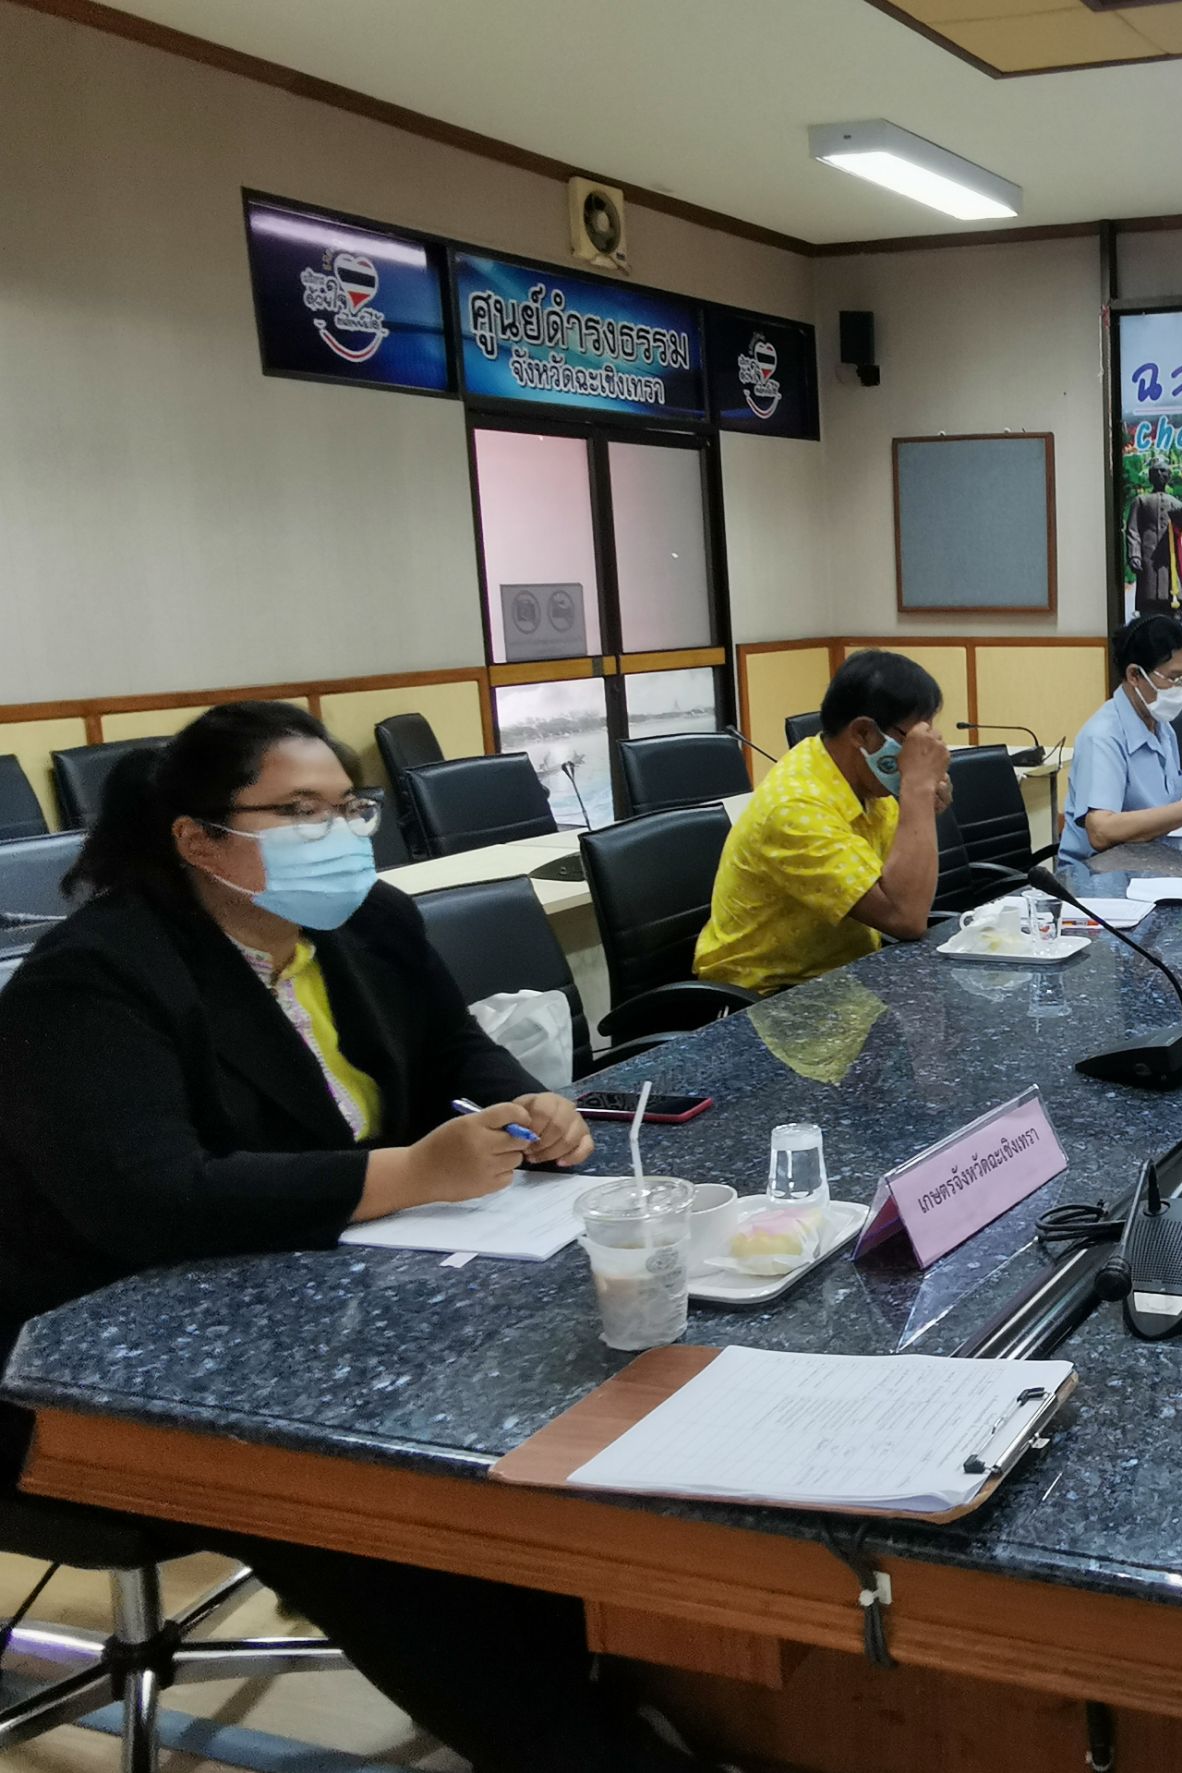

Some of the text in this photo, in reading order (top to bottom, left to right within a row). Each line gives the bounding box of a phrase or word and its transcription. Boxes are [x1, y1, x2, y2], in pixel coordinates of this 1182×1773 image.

[470, 284, 689, 369] ศูนย์ดำรงธรรม
[511, 348, 665, 404] จังหวัดฉะเชิงเทรา
[918, 1127, 1041, 1213] เกษตรจังหวัดฉะเชิงเทรา
